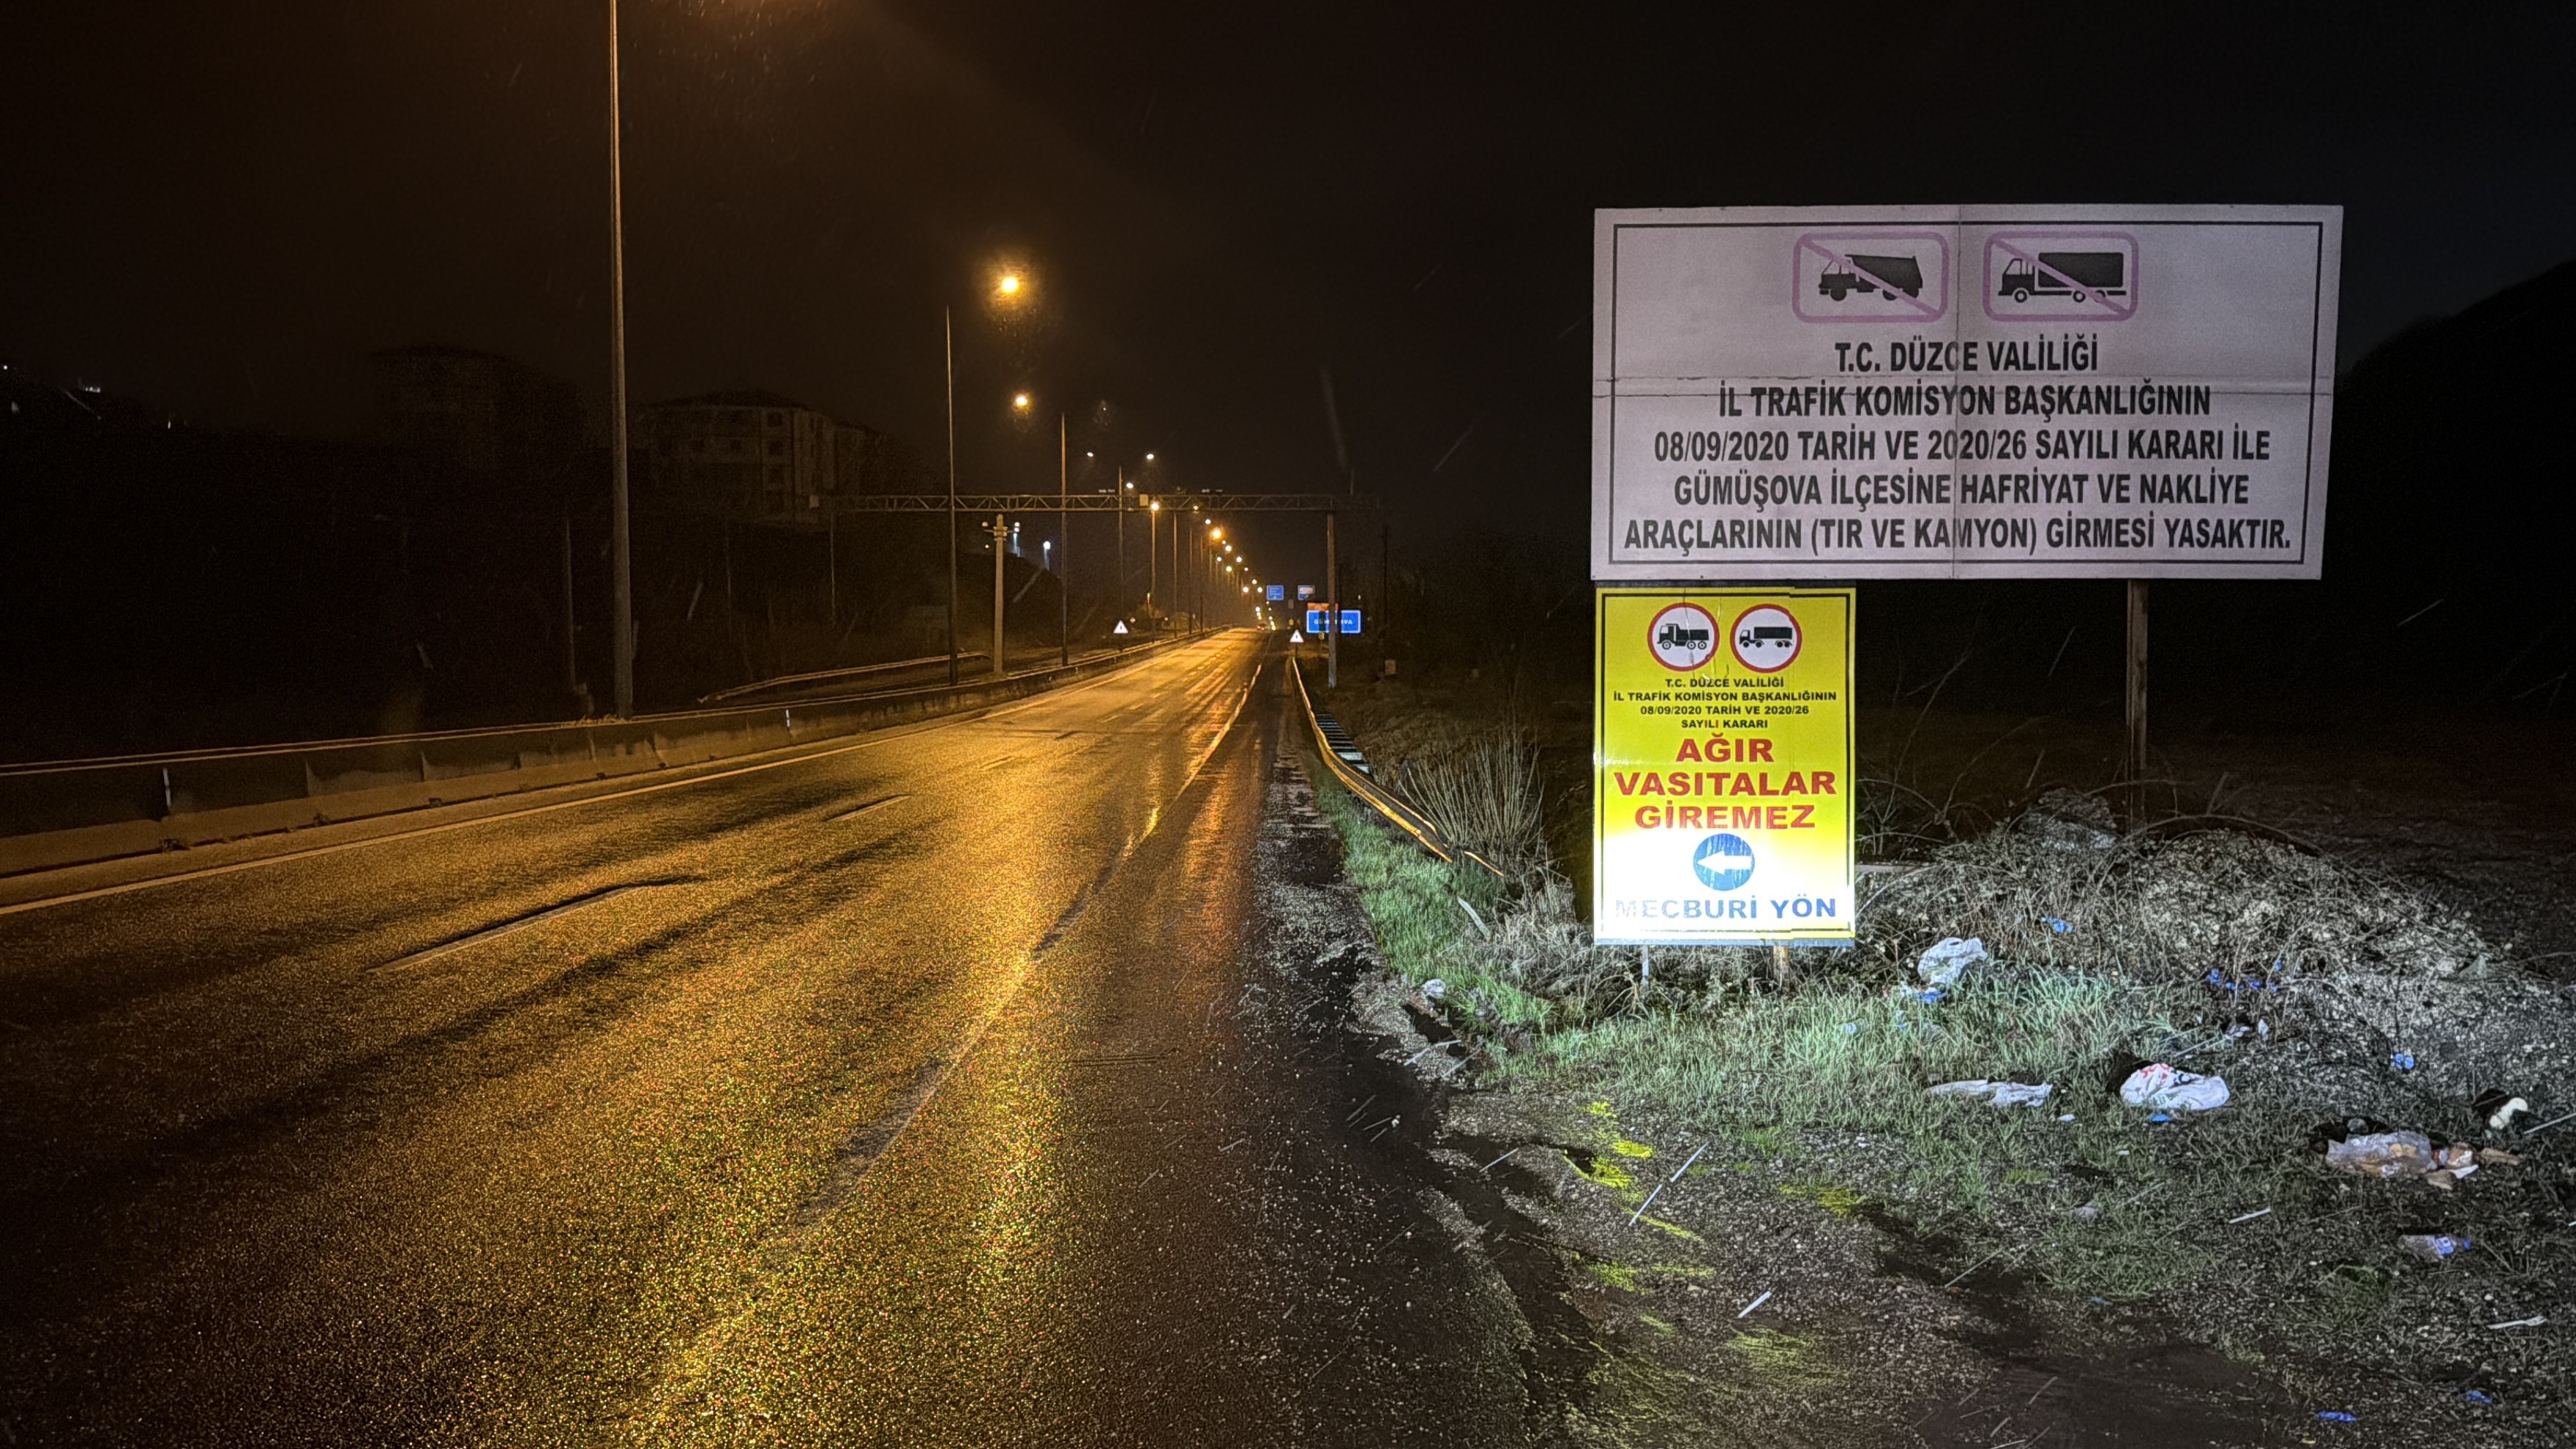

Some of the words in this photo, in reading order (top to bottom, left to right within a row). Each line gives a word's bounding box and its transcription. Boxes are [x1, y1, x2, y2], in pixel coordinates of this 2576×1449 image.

[1835, 342, 1881, 372] T.C.
[1890, 335, 1978, 372] DÜZCE
[1987, 333, 2097, 371] VALİLİĞİ
[1719, 379, 1743, 417] İL
[1751, 378, 1846, 417] TRAFİK
[1855, 378, 1995, 416] KOMİSYON
[2004, 378, 2211, 422] BAŞKANLIĞININ
[1654, 430, 1789, 463] 08/09/2020
[1797, 423, 1876, 460] TARİH
[1884, 430, 1919, 460] VE
[1927, 429, 2026, 460] 2020/26
[2035, 429, 2119, 460] SAYILI
[2128, 429, 2224, 460] KARARI
[2233, 422, 2270, 460] İLE
[1674, 469, 1822, 512] GÜMÜŞOVA
[1831, 467, 1951, 510] İLÇESİNE
[1960, 466, 2089, 504] HAFRİYAT
[2097, 473, 2131, 503] VE
[2140, 468, 2249, 503] NAKLİYE
[1624, 519, 1802, 557] ARAÇLARININ
[1811, 518, 1862, 556] (TIR
[1871, 518, 1905, 548] VE
[1914, 517, 2037, 555] KAMYON)
[2046, 511, 2154, 548] GİRMESİ
[2163, 518, 2291, 549] YASAKTIR.
[1613, 690, 1625, 701] İL
[1628, 690, 1671, 701] TRAFİK
[1674, 690, 1738, 701] KOMİSYON
[1742, 690, 1837, 703] BAŞKANLIĞININ
[1665, 678, 1686, 688] T.C.
[1690, 676, 1730, 688] DÜZCE
[1733, 676, 1784, 688] VALİLİĞİ
[1640, 705, 1702, 715] 08/09/2020
[1705, 704, 1741, 715] TARİH
[1745, 705, 1761, 715] VE
[1764, 705, 1810, 715] 2020/26
[1681, 719, 1719, 729] SAYILI
[1723, 719, 1768, 729] KARARI
[1675, 732, 1775, 763] AĞIR
[1613, 771, 1837, 796] VASITALAR
[1634, 799, 1816, 829] GİREMEZ
[1615, 894, 1757, 919] MECBURİ
[1770, 893, 1836, 918] YÖN
